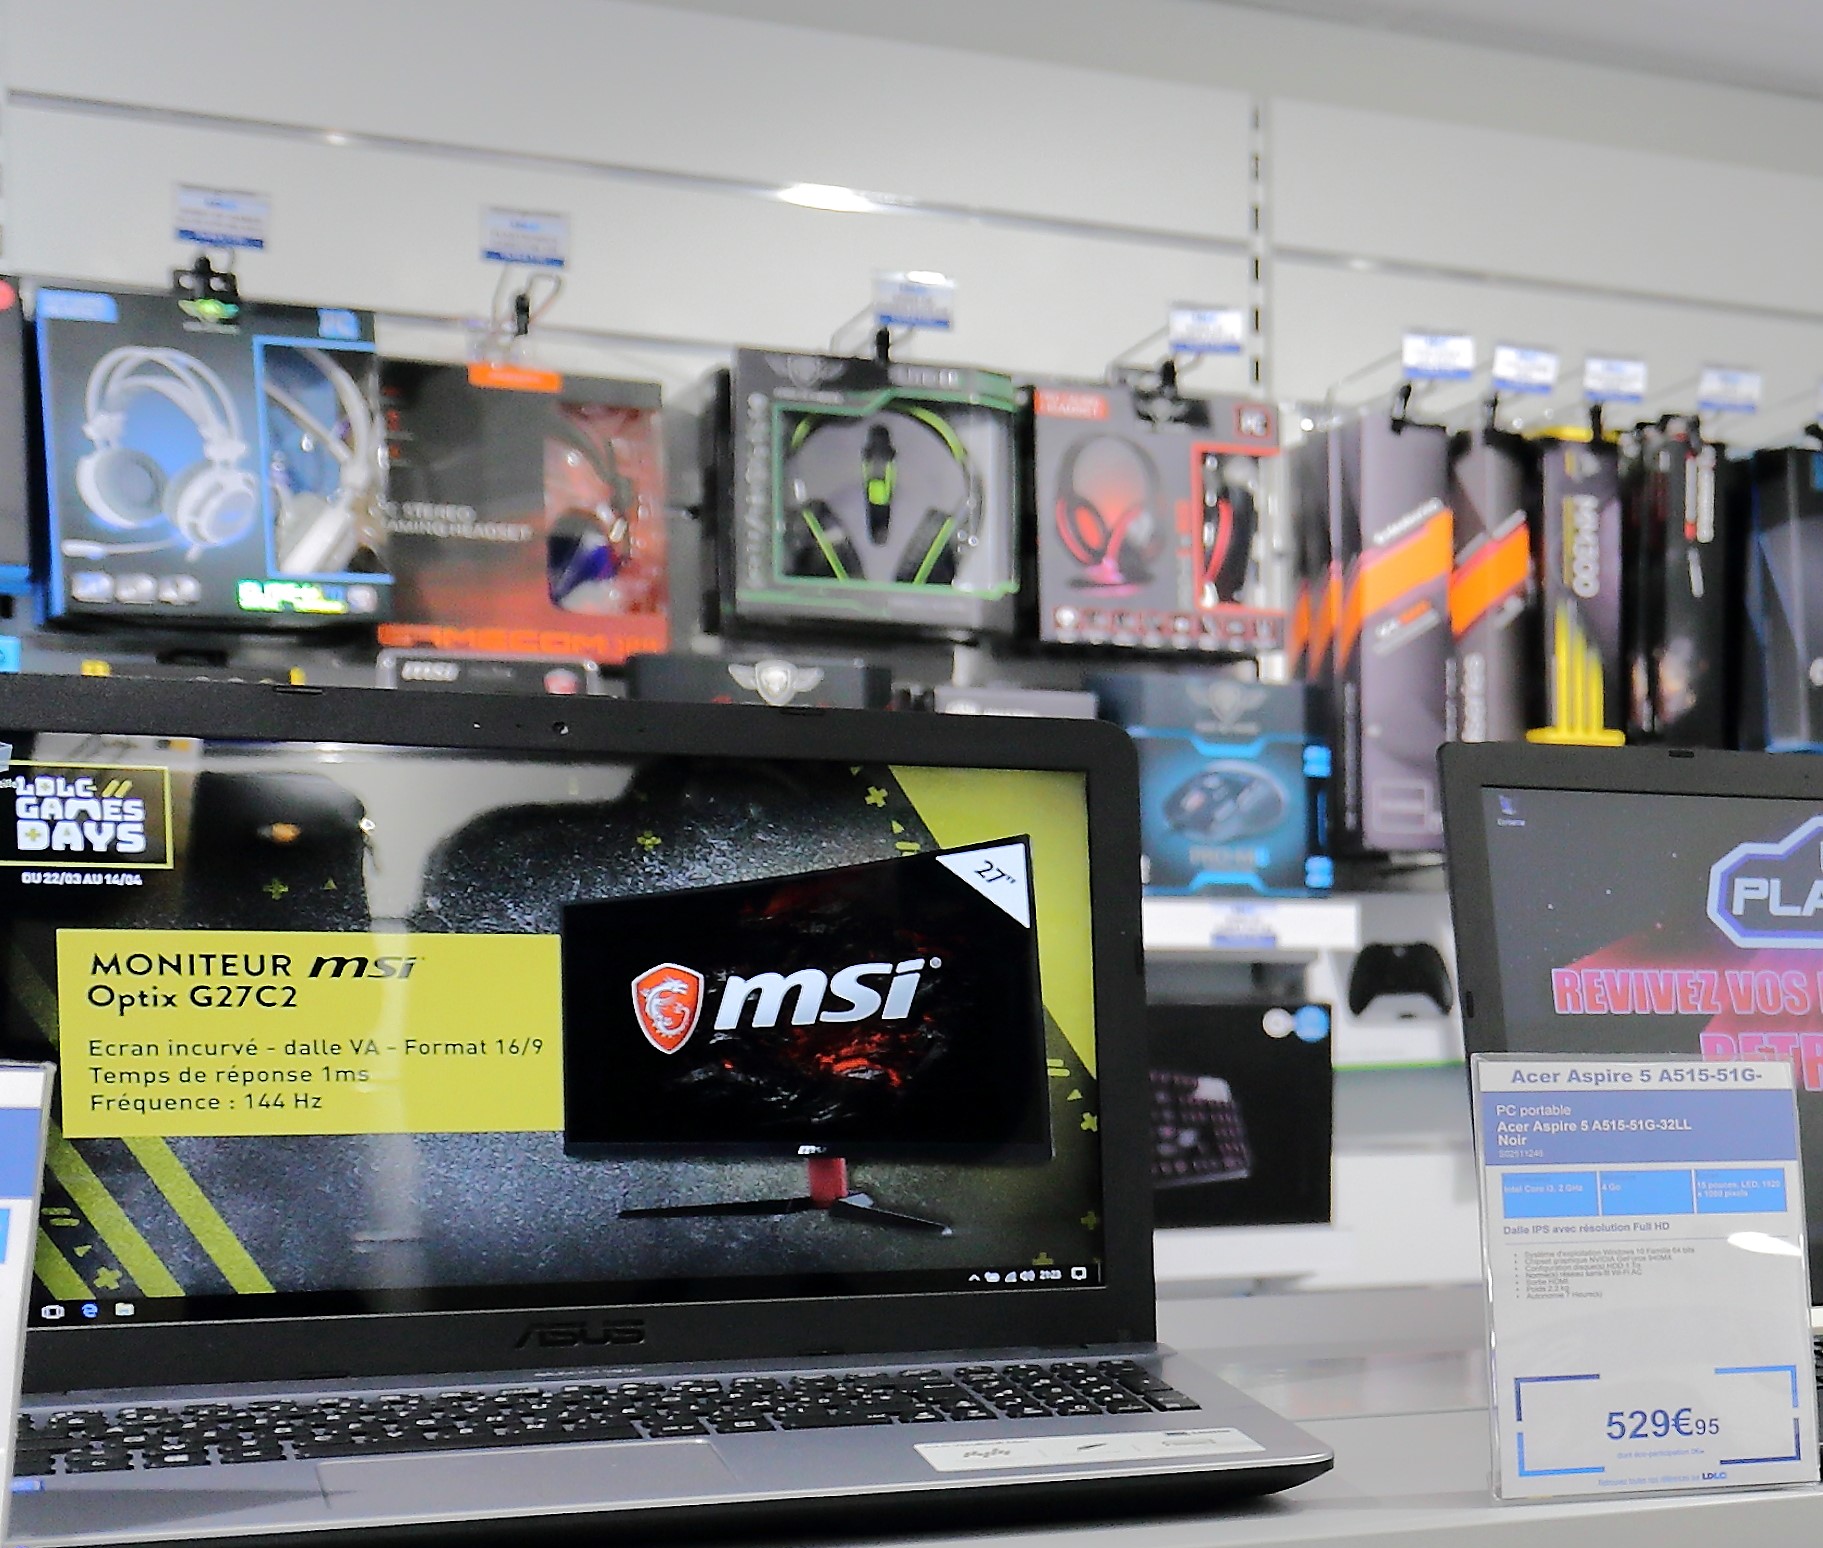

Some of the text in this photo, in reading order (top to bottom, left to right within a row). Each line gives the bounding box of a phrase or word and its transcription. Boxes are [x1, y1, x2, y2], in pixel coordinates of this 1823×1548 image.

[15, 775, 97, 797] LDLC
[15, 796, 146, 822] GAMES
[16, 819, 147, 853] DAYS
[91, 953, 417, 979] MONITEUR msi
[88, 985, 297, 1016] Optix G27C2
[713, 957, 926, 1031] msi
[1551, 968, 1722, 1015] REVIVEZ
[1725, 970, 1809, 1016] VOS
[90, 1037, 543, 1057] Ecran incurvé dalle VA Format 16/9
[90, 1064, 369, 1088] Temps de réponse 1ms
[1512, 1068, 1763, 1085] Acer Aspire 5 A515-51G-
[91, 1092, 322, 1116] Fréquence 144 Hz
[1496, 1104, 1571, 1118] PC portable
[1497, 1121, 1530, 1133] Acer
[1532, 1120, 1577, 1134] Aspire
[1580, 1120, 1588, 1132] 5
[1498, 1135, 1527, 1146] Noir
[1532, 1224, 1550, 1234] IPS
[1655, 1222, 1670, 1231] HD
[514, 1318, 646, 1350] ASUS
[1606, 1408, 1720, 1441] 529€95
